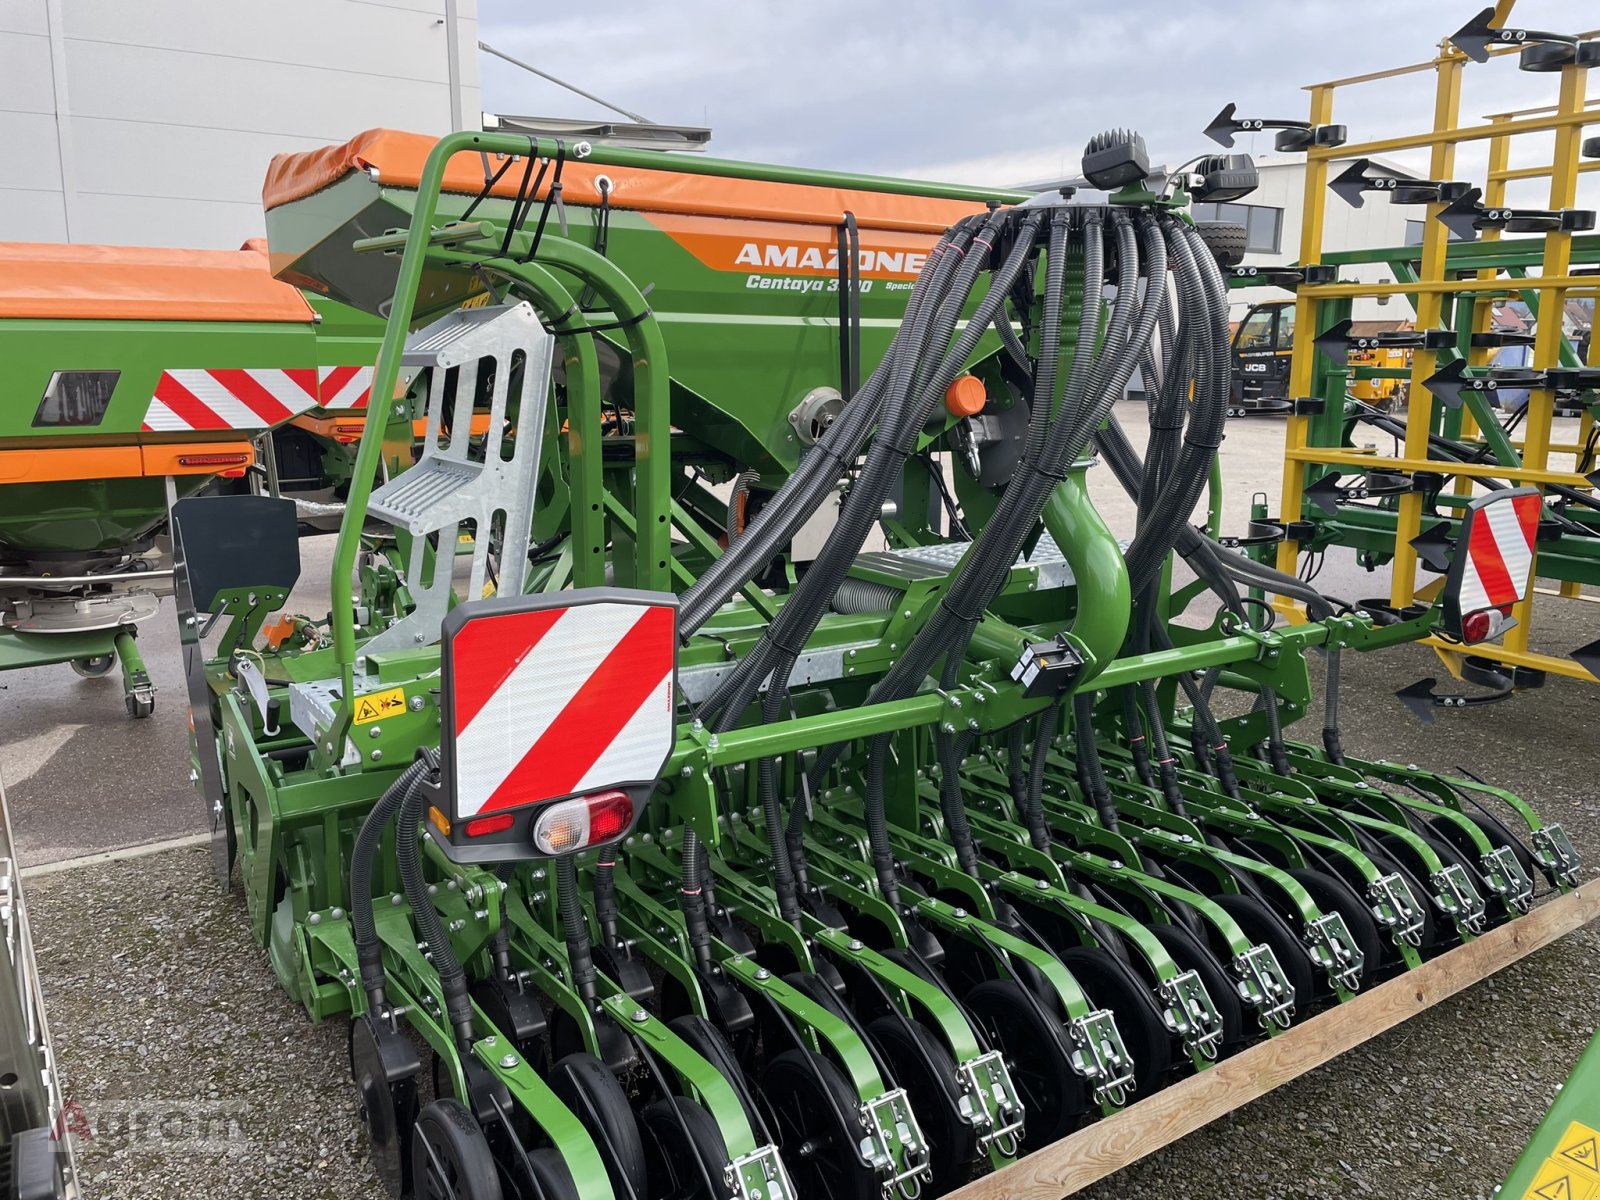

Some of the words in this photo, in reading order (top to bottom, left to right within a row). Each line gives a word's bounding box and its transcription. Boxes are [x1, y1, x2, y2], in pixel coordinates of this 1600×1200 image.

[735, 243, 928, 273] AMAZONE
[746, 274, 824, 293] Centaya
[827, 278, 873, 293] 30
[1245, 363, 1266, 371] JCB
